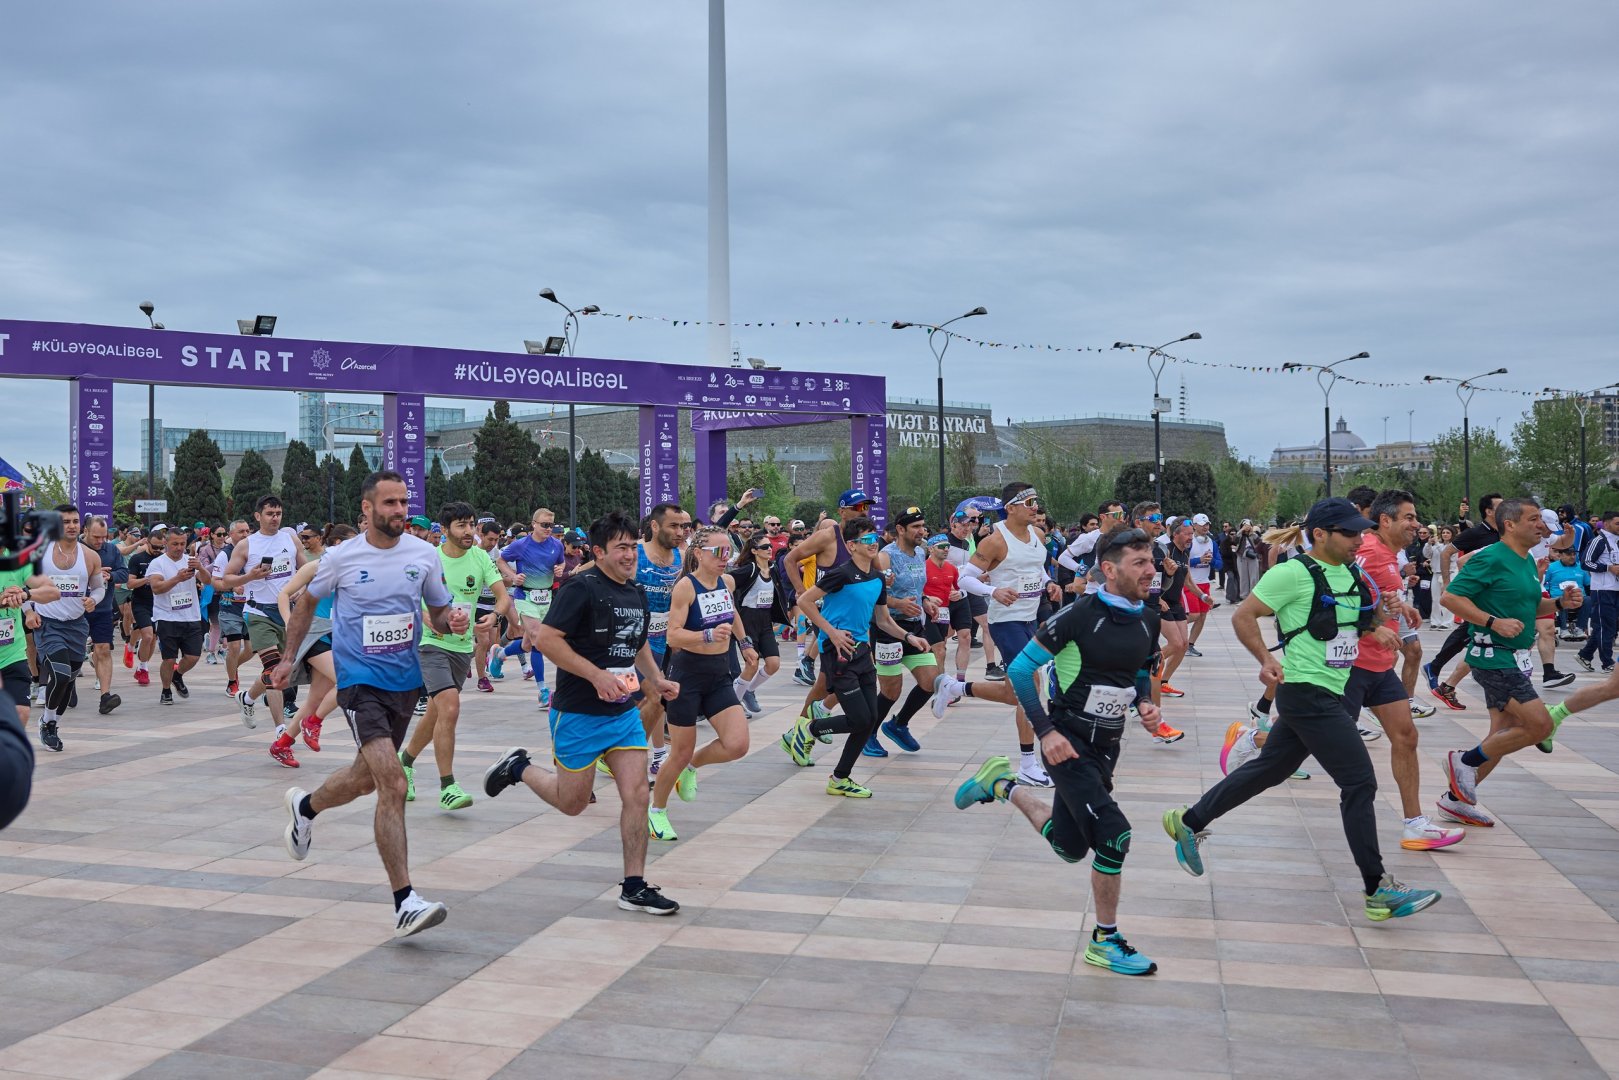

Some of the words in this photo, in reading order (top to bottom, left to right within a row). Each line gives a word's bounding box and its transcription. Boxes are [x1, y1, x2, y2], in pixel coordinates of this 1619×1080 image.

[32, 338, 163, 359] #KÜLƏYƏQALİBGƏL
[181, 345, 294, 373] START
[454, 361, 628, 390] #KÜLƏYƏQALİBGƏL
[744, 395, 757, 404] GO
[613, 607, 645, 618] RUNNIN
[704, 601, 732, 615] 23576
[369, 628, 409, 643] 16833
[1333, 645, 1356, 658] 1744
[1095, 701, 1127, 716] 3929
